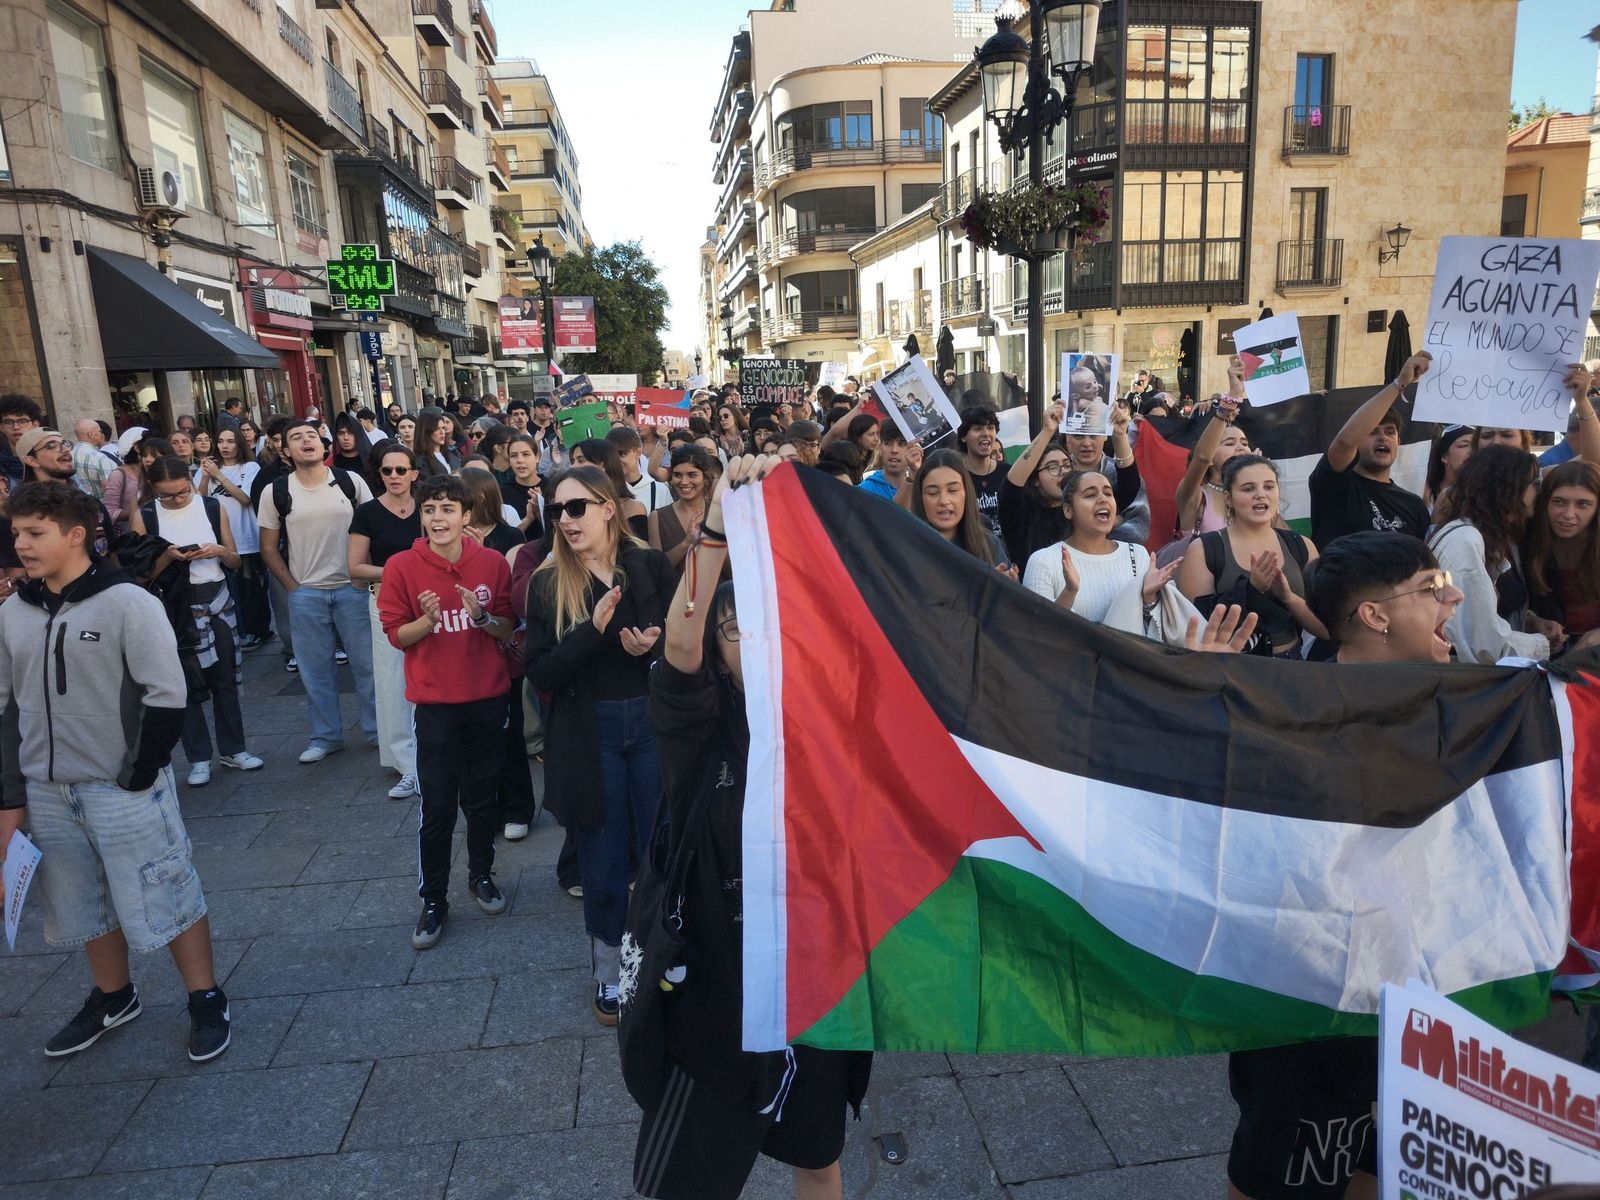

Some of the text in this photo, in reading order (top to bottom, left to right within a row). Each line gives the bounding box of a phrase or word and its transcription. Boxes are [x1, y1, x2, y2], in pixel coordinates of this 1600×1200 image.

[1067, 151, 1118, 169] piccolinos
[1480, 243, 1562, 275] GAZA
[1441, 275, 1579, 319] AGUANTA
[1427, 320, 1579, 356] EL MUNDO SE
[742, 360, 800, 369] IGNORAR EL
[1260, 361, 1300, 377] PALESTINE
[742, 368, 805, 386] GENOCIDIO
[742, 385, 754, 394] ES
[616, 392, 636, 405] OLÉ
[742, 395, 757, 404] SER
[638, 413, 690, 428] PALESTINA
[1401, 1008, 1597, 1132] Militante
[1492, 1095, 1502, 1107] DE
[1402, 1098, 1525, 1178] PAREMOS
